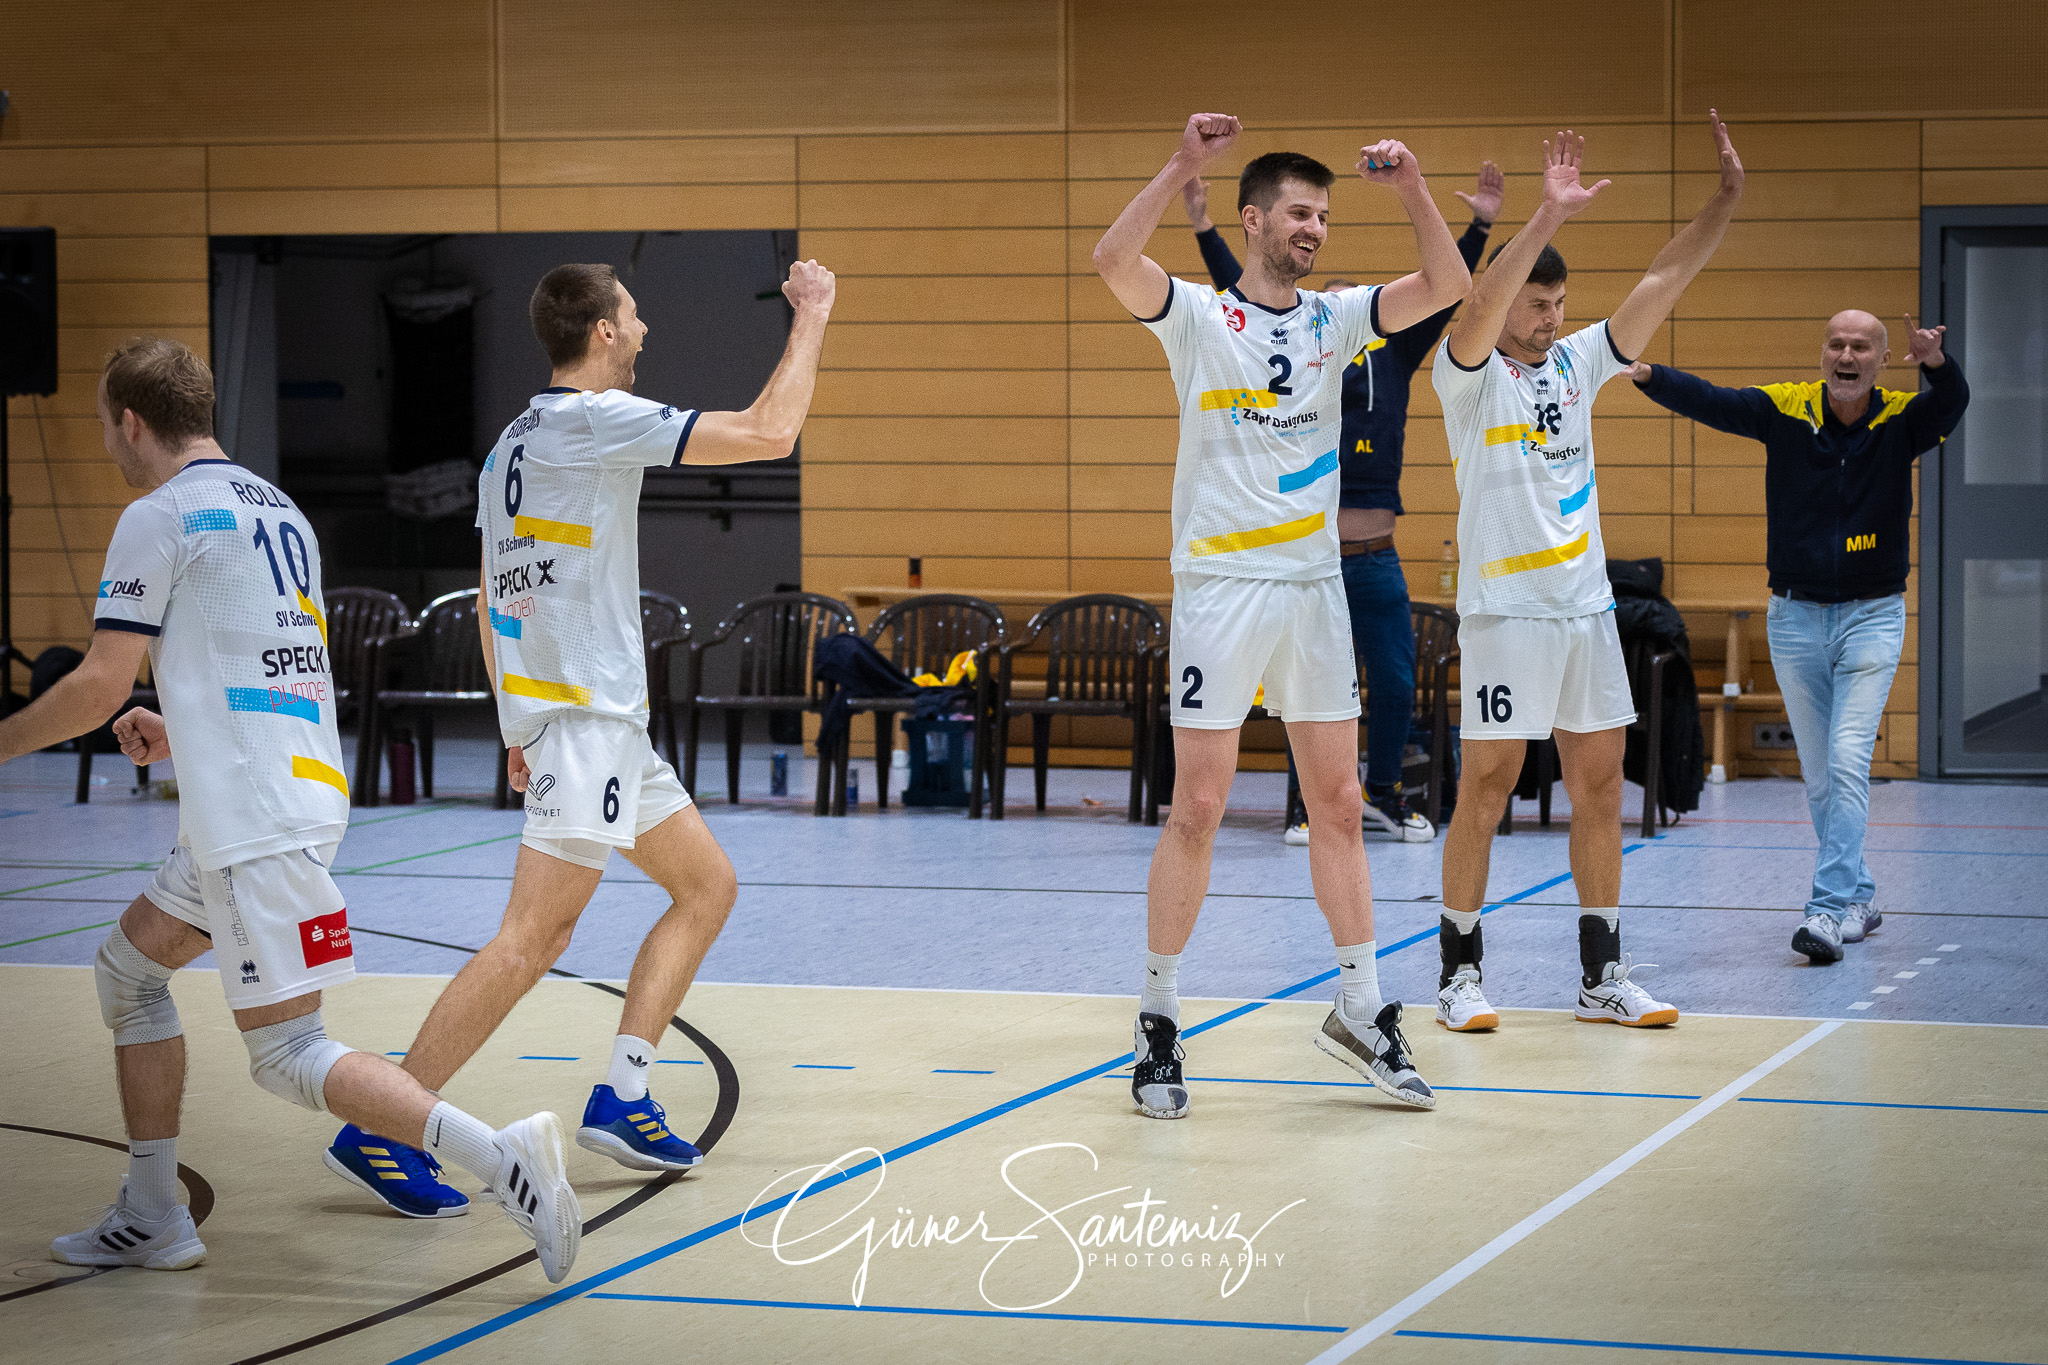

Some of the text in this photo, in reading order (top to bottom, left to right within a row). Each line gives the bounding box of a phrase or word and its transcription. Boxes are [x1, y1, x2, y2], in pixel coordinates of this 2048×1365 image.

[1268, 354, 1292, 396] 2
[1243, 408, 1271, 425] Zapf
[1534, 402, 1562, 436] 16
[1355, 439, 1373, 453] AL
[229, 481, 289, 508] ROLL
[505, 444, 524, 518] 6
[253, 518, 310, 598] 10
[505, 531, 536, 553] Schwaig
[1846, 533, 1876, 552] MM
[110, 578, 147, 598] puls
[276, 611, 289, 628] SV
[261, 645, 325, 678] SPECK
[1181, 665, 1203, 709] 2
[1476, 685, 1513, 723] 16
[603, 776, 620, 823] 6
